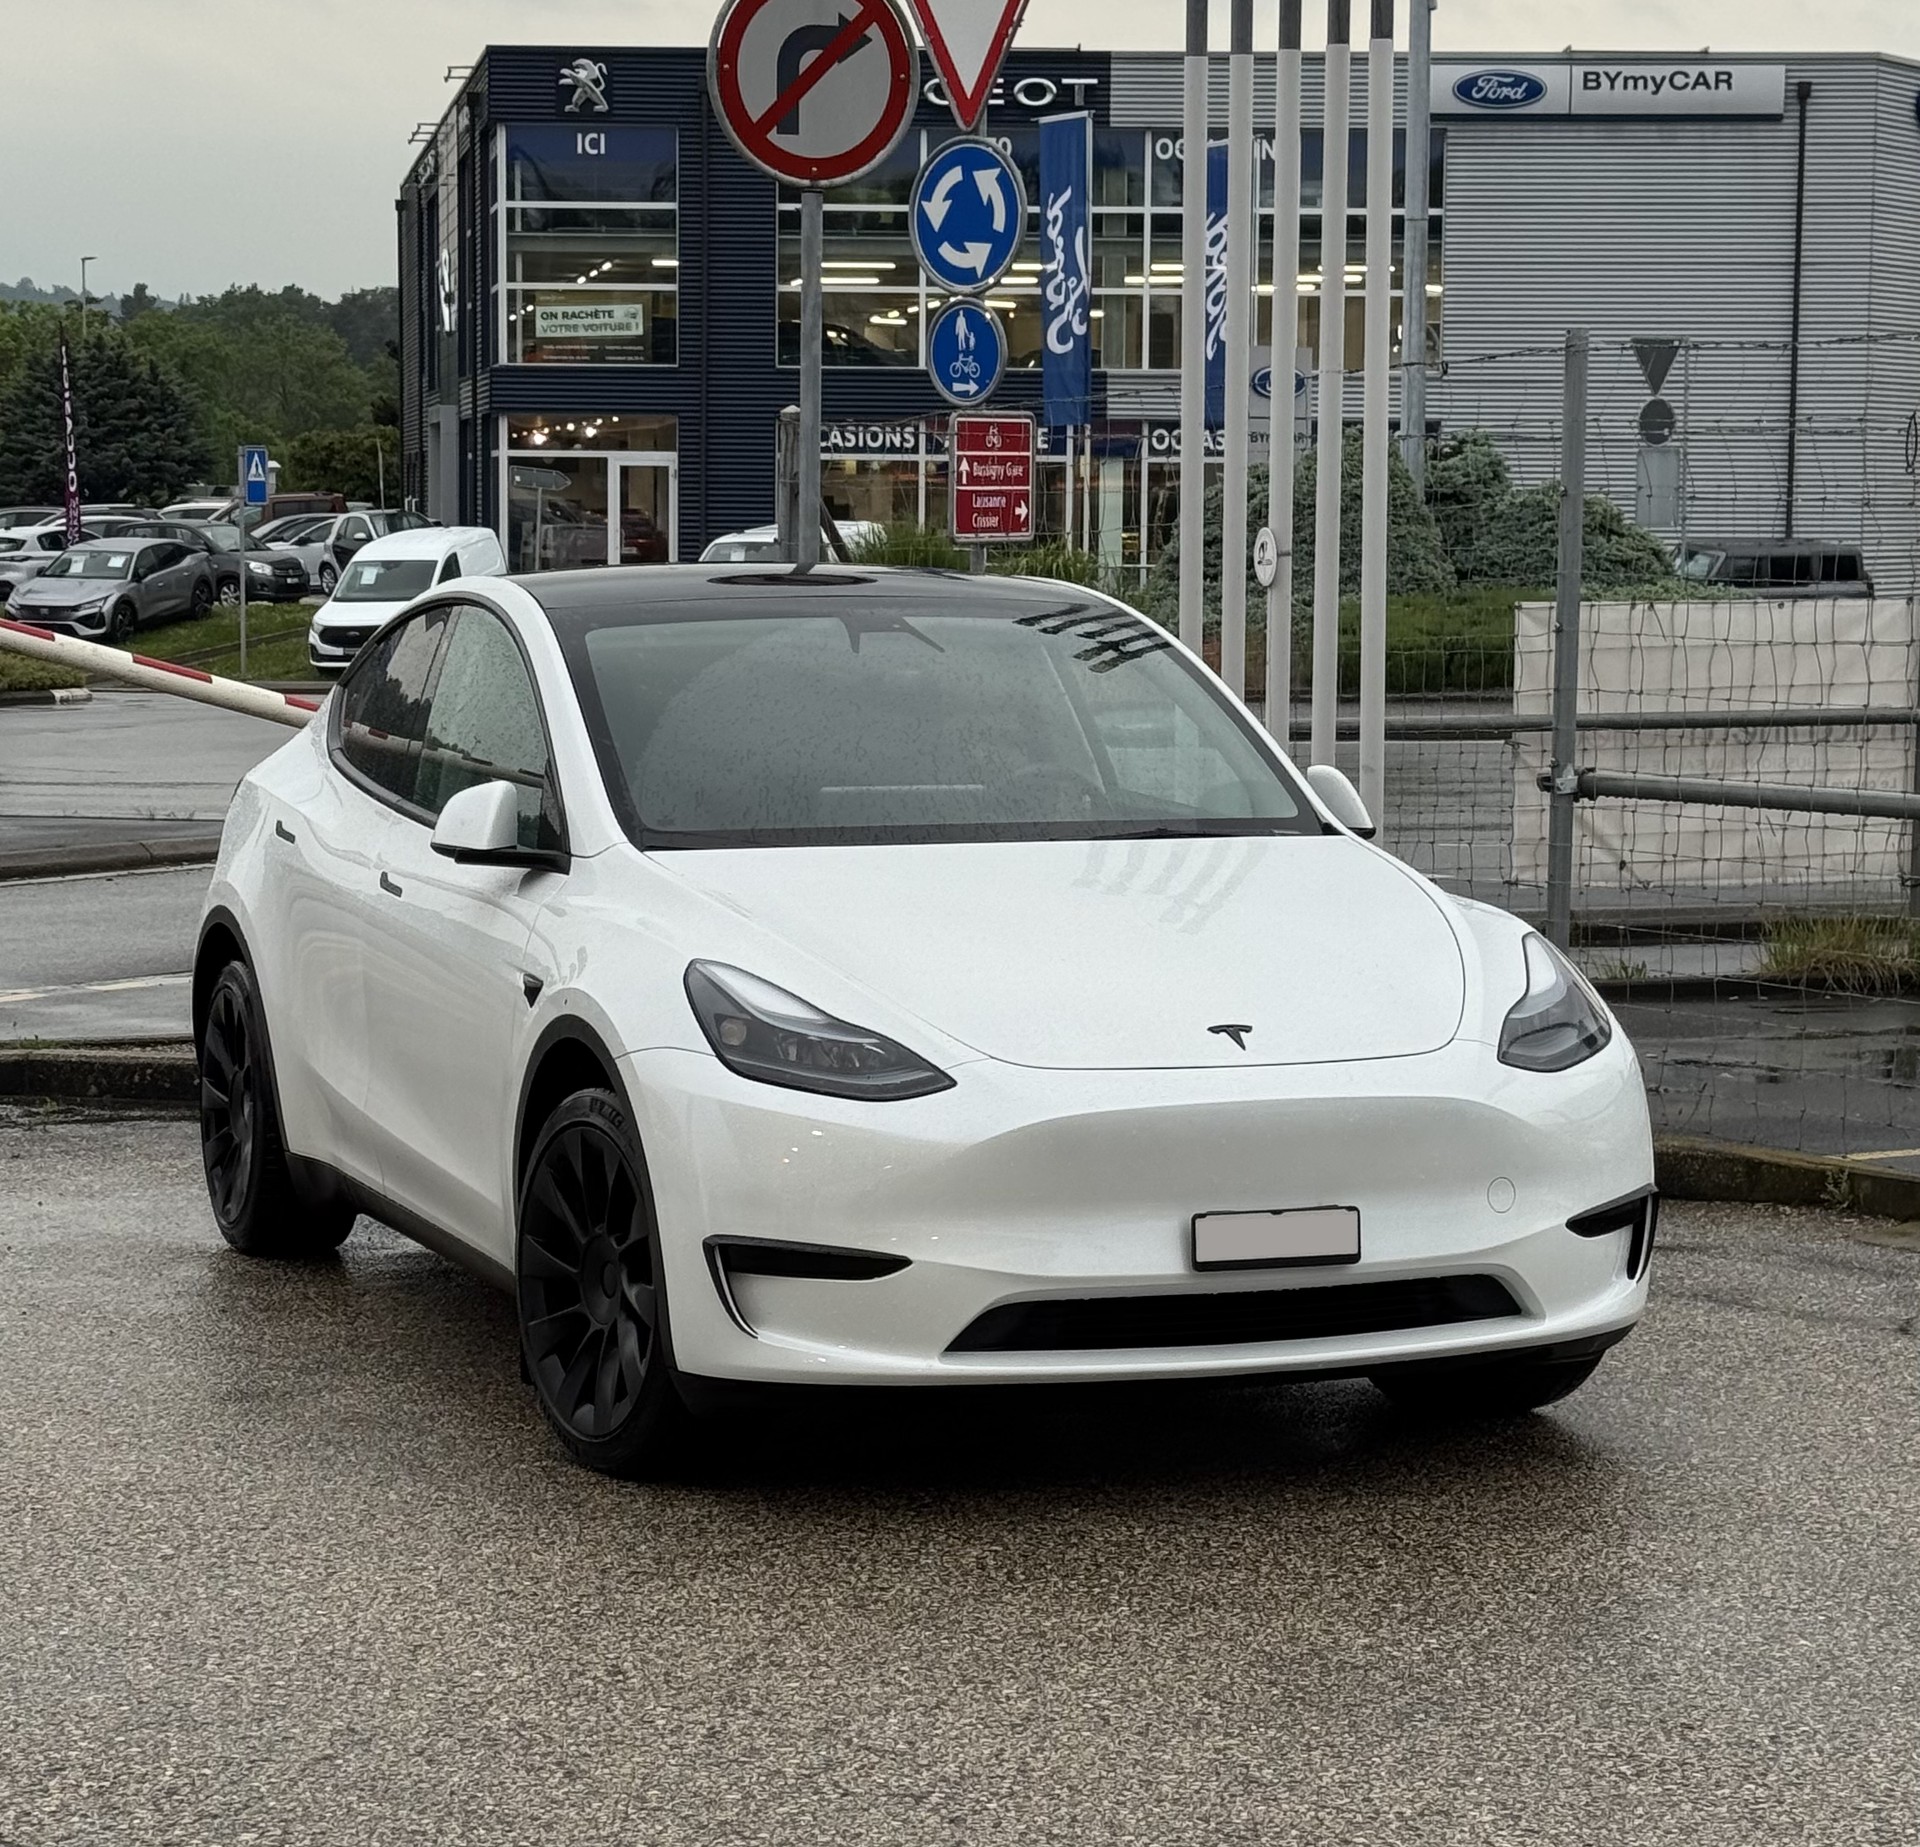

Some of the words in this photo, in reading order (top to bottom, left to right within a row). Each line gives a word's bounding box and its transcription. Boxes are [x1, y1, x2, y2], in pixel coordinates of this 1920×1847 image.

[1471, 76, 1527, 101] Ford
[1582, 70, 1733, 96] BYmyCAR
[576, 132, 606, 155] ICI
[540, 310, 558, 321] ON
[561, 308, 615, 320] RACHÈTE
[540, 324, 579, 334] VOTRE
[582, 322, 633, 333] VOITURE
[972, 493, 1007, 508] Lausanne
[972, 512, 1000, 528] Crissier
